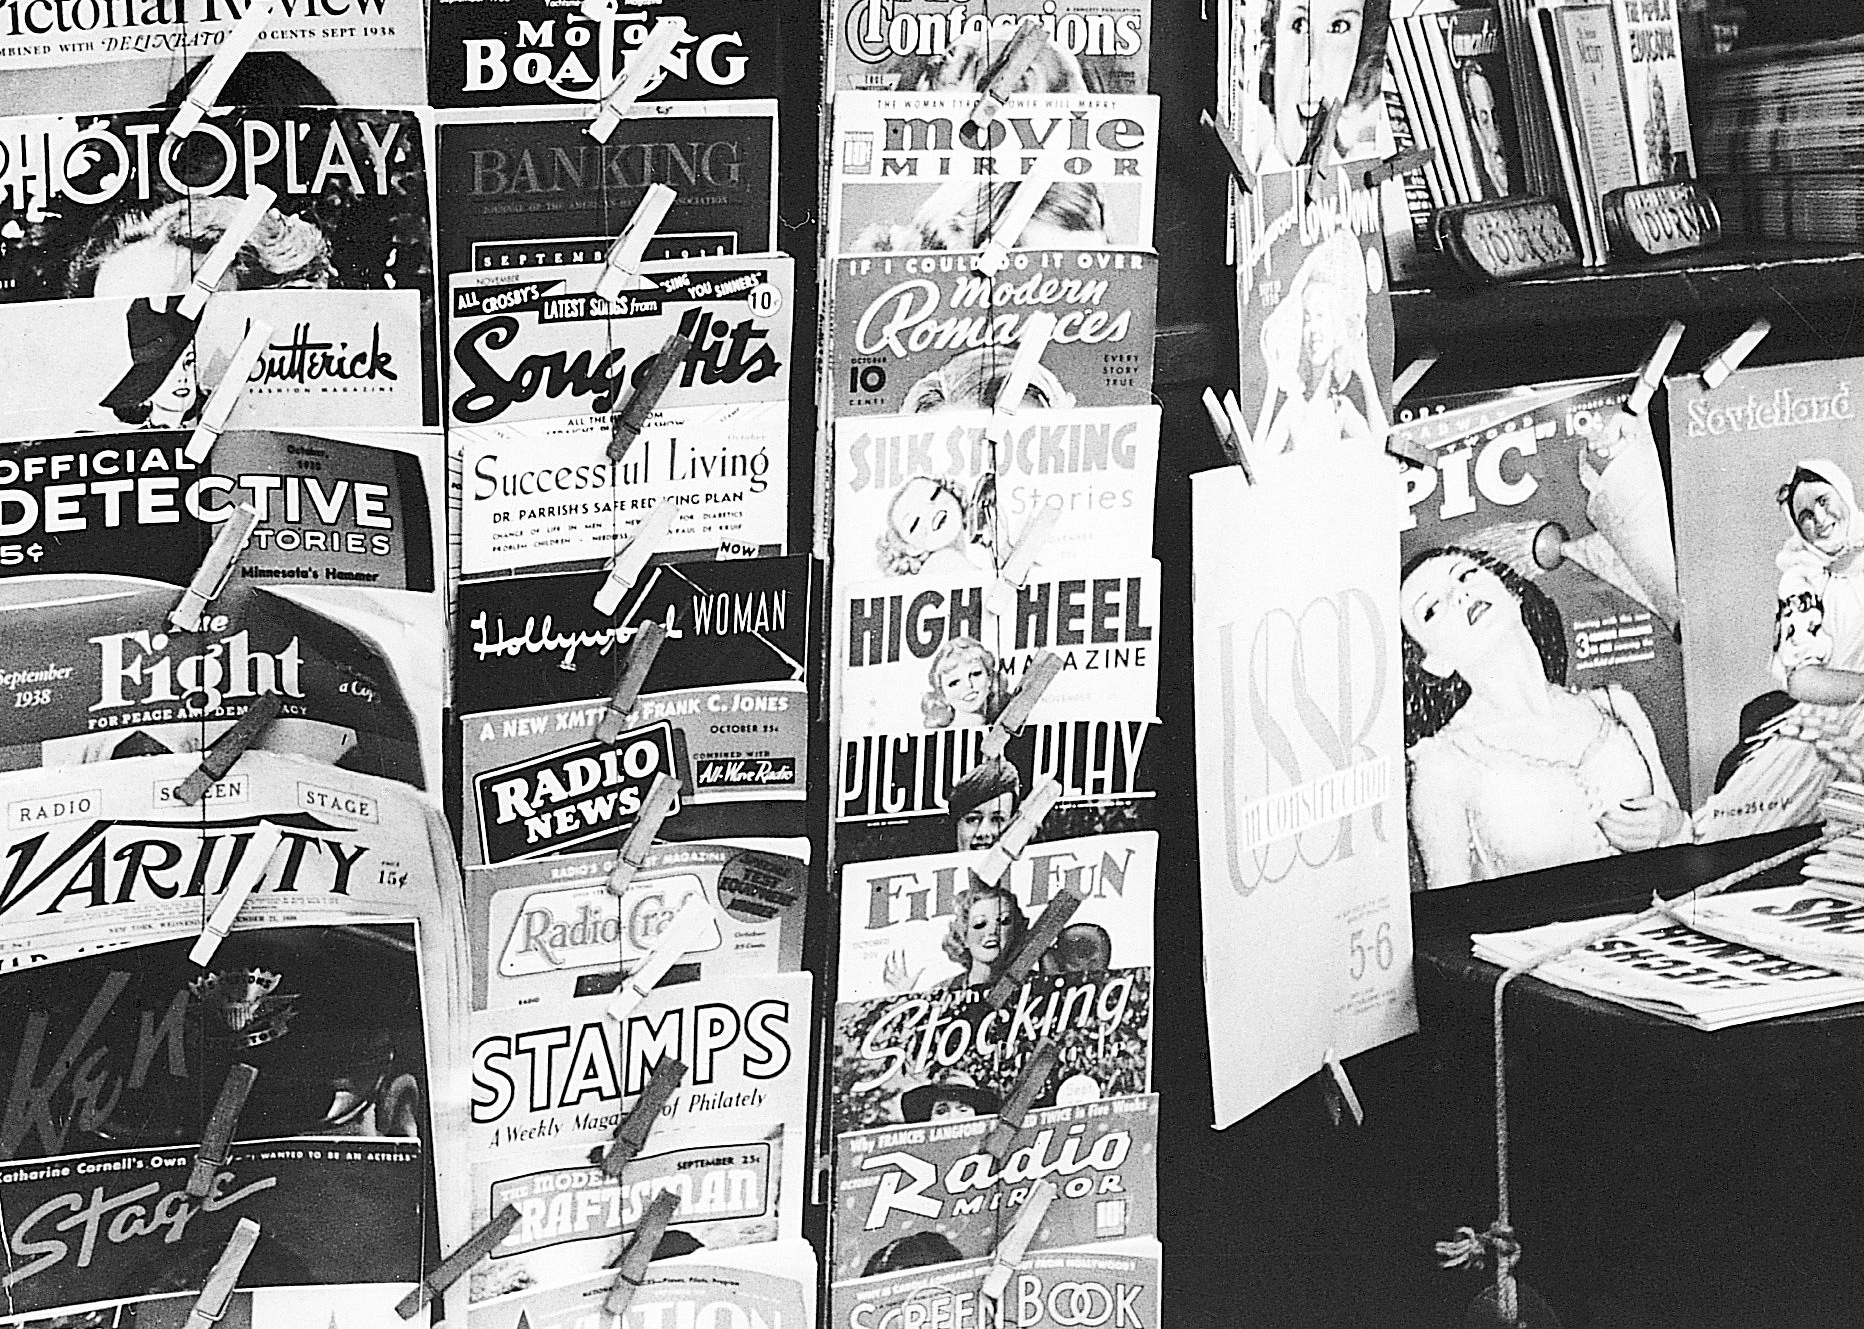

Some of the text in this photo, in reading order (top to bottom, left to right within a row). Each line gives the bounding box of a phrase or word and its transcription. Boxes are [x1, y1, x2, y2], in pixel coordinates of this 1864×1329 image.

[884, 110, 1145, 151] movie
[468, 141, 744, 196] BANKING
[882, 157, 1142, 177] MIRROR
[1077, 255, 1143, 271] OVER
[458, 282, 712, 318] ALL CROSBY'S LATEST from YOU
[950, 273, 1109, 308] Modern
[855, 278, 1132, 359] Romances
[452, 315, 626, 424] Song
[849, 365, 887, 393] 10
[0, 448, 196, 484] OFFICIAL
[668, 437, 770, 494] Living
[945, 421, 1138, 477] STOCKING
[0, 473, 392, 538] DETECTIVE
[706, 491, 744, 503] PLAN
[1011, 485, 1134, 515] Stories
[720, 541, 755, 556] NOW
[693, 590, 787, 636] WOMAN
[849, 576, 1152, 667] HIGH HEEL
[88, 629, 305, 713] Fight
[14, 690, 51, 708] 1938
[88, 709, 172, 730] FOR PEACE
[730, 695, 789, 713] JONES
[493, 737, 660, 823] RADIO
[20, 799, 91, 822] RADIO
[306, 791, 369, 816] STAGE
[524, 792, 642, 844] NEWS
[852, 972, 1136, 1092] Stocking
[471, 1000, 790, 1123] STAMPS
[506, 1089, 767, 1142] Weekly Philately
[150, 1155, 186, 1169] Own
[677, 1157, 734, 1171] SEPTEMBER
[861, 1124, 1132, 1231] Radio
[2, 1172, 276, 1287] Stage
[1017, 1273, 1145, 1329] BOOK
